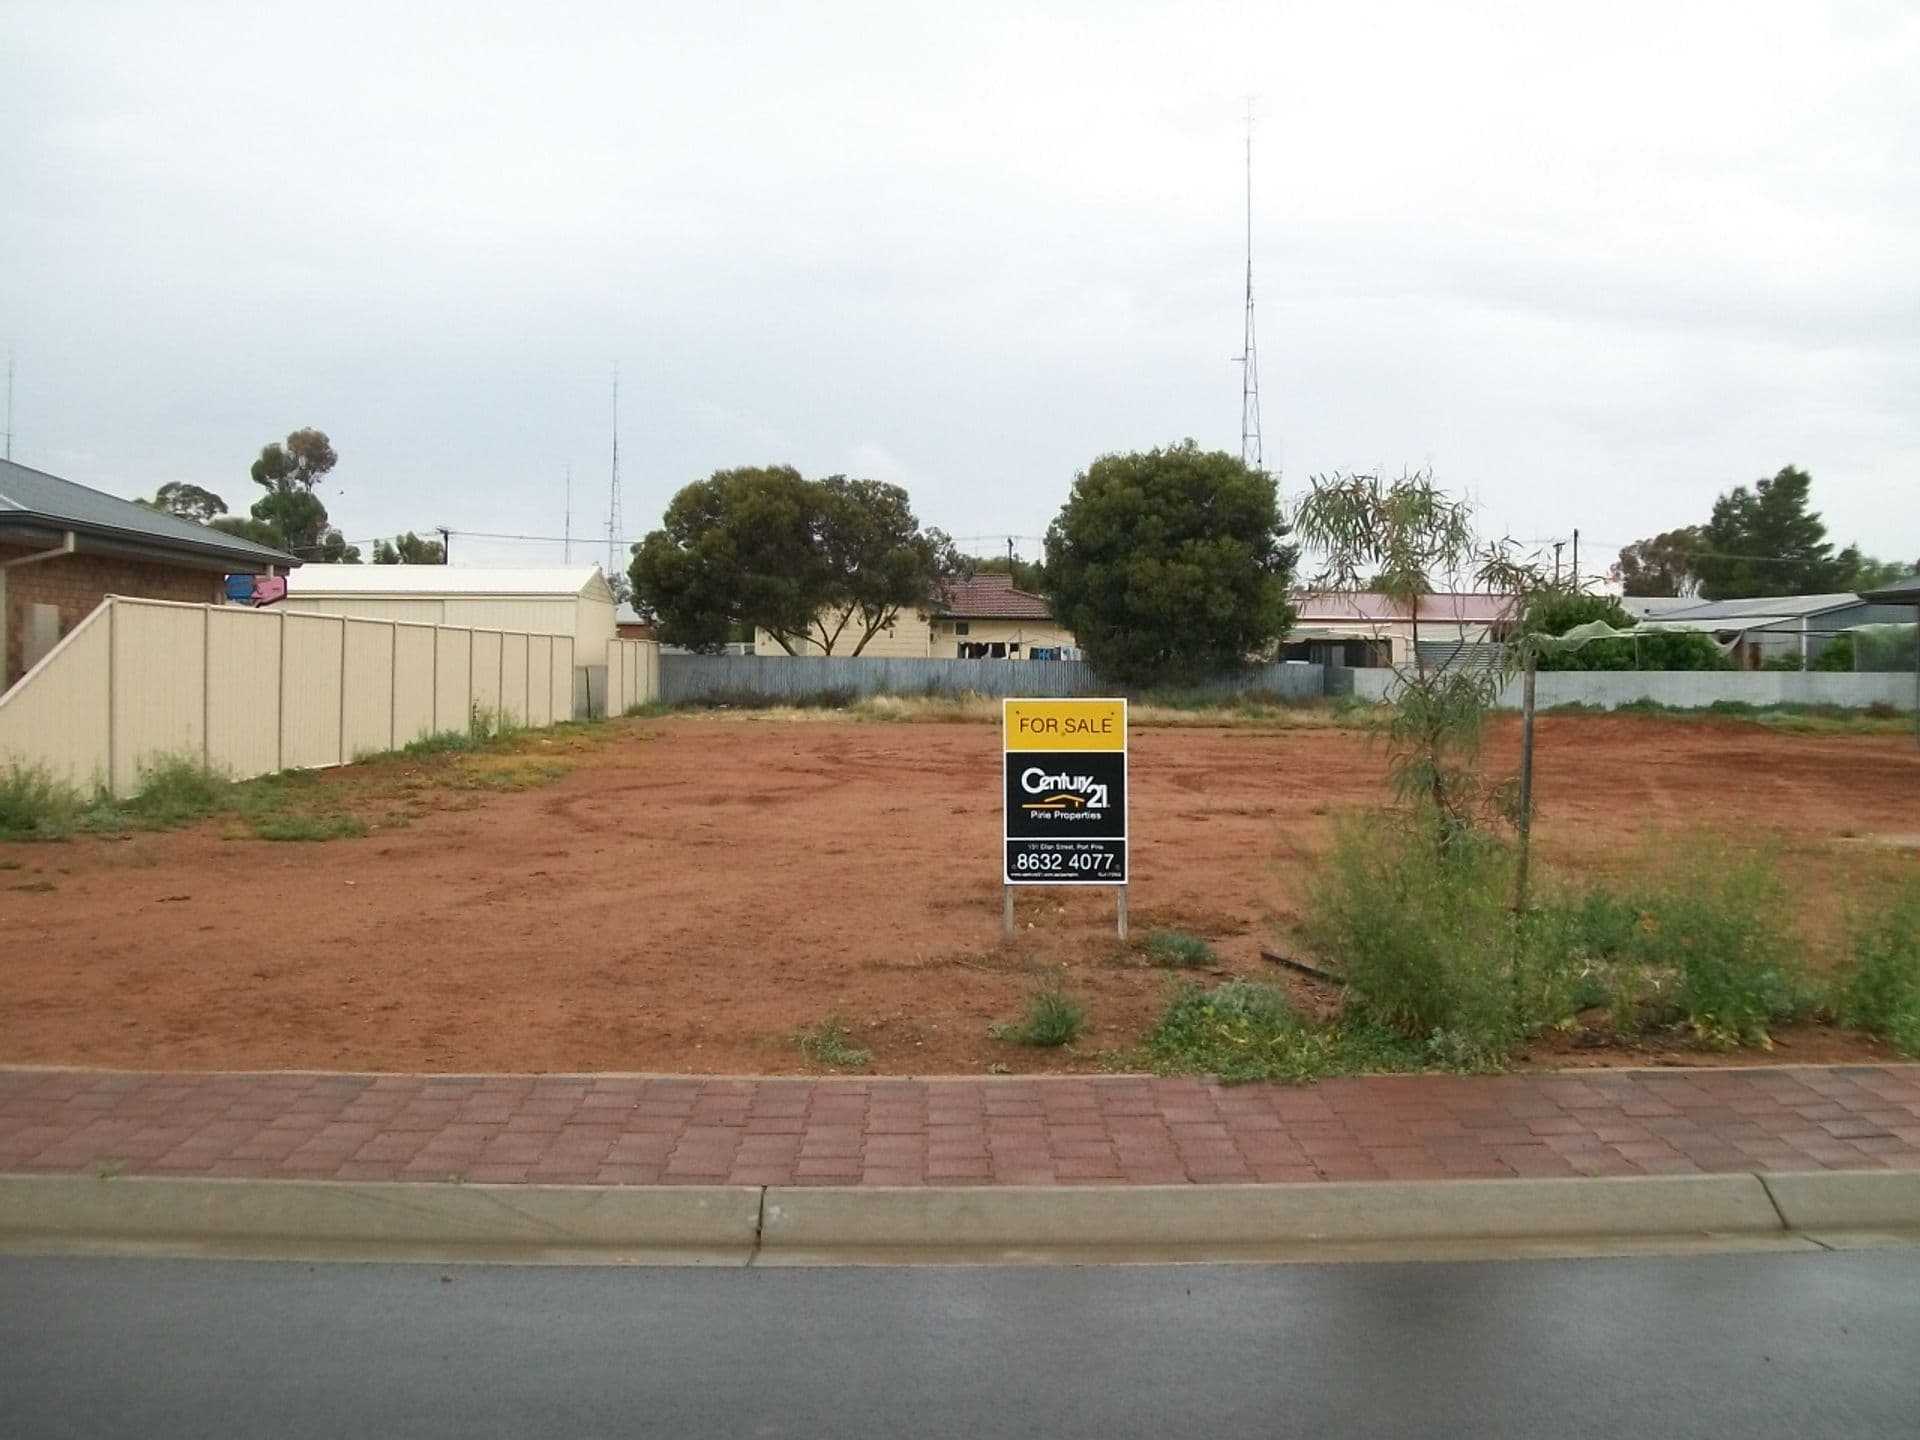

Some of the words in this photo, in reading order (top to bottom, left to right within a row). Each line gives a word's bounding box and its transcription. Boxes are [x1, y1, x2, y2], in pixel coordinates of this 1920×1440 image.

[1020, 718, 1058, 733] FOR
[1064, 718, 1113, 733] SALE
[1021, 767, 1094, 794] Century
[1086, 784, 1108, 808] 21
[1054, 810, 1101, 821] Properties
[1017, 853, 1062, 870] 8632
[1068, 853, 1114, 870] 4077
